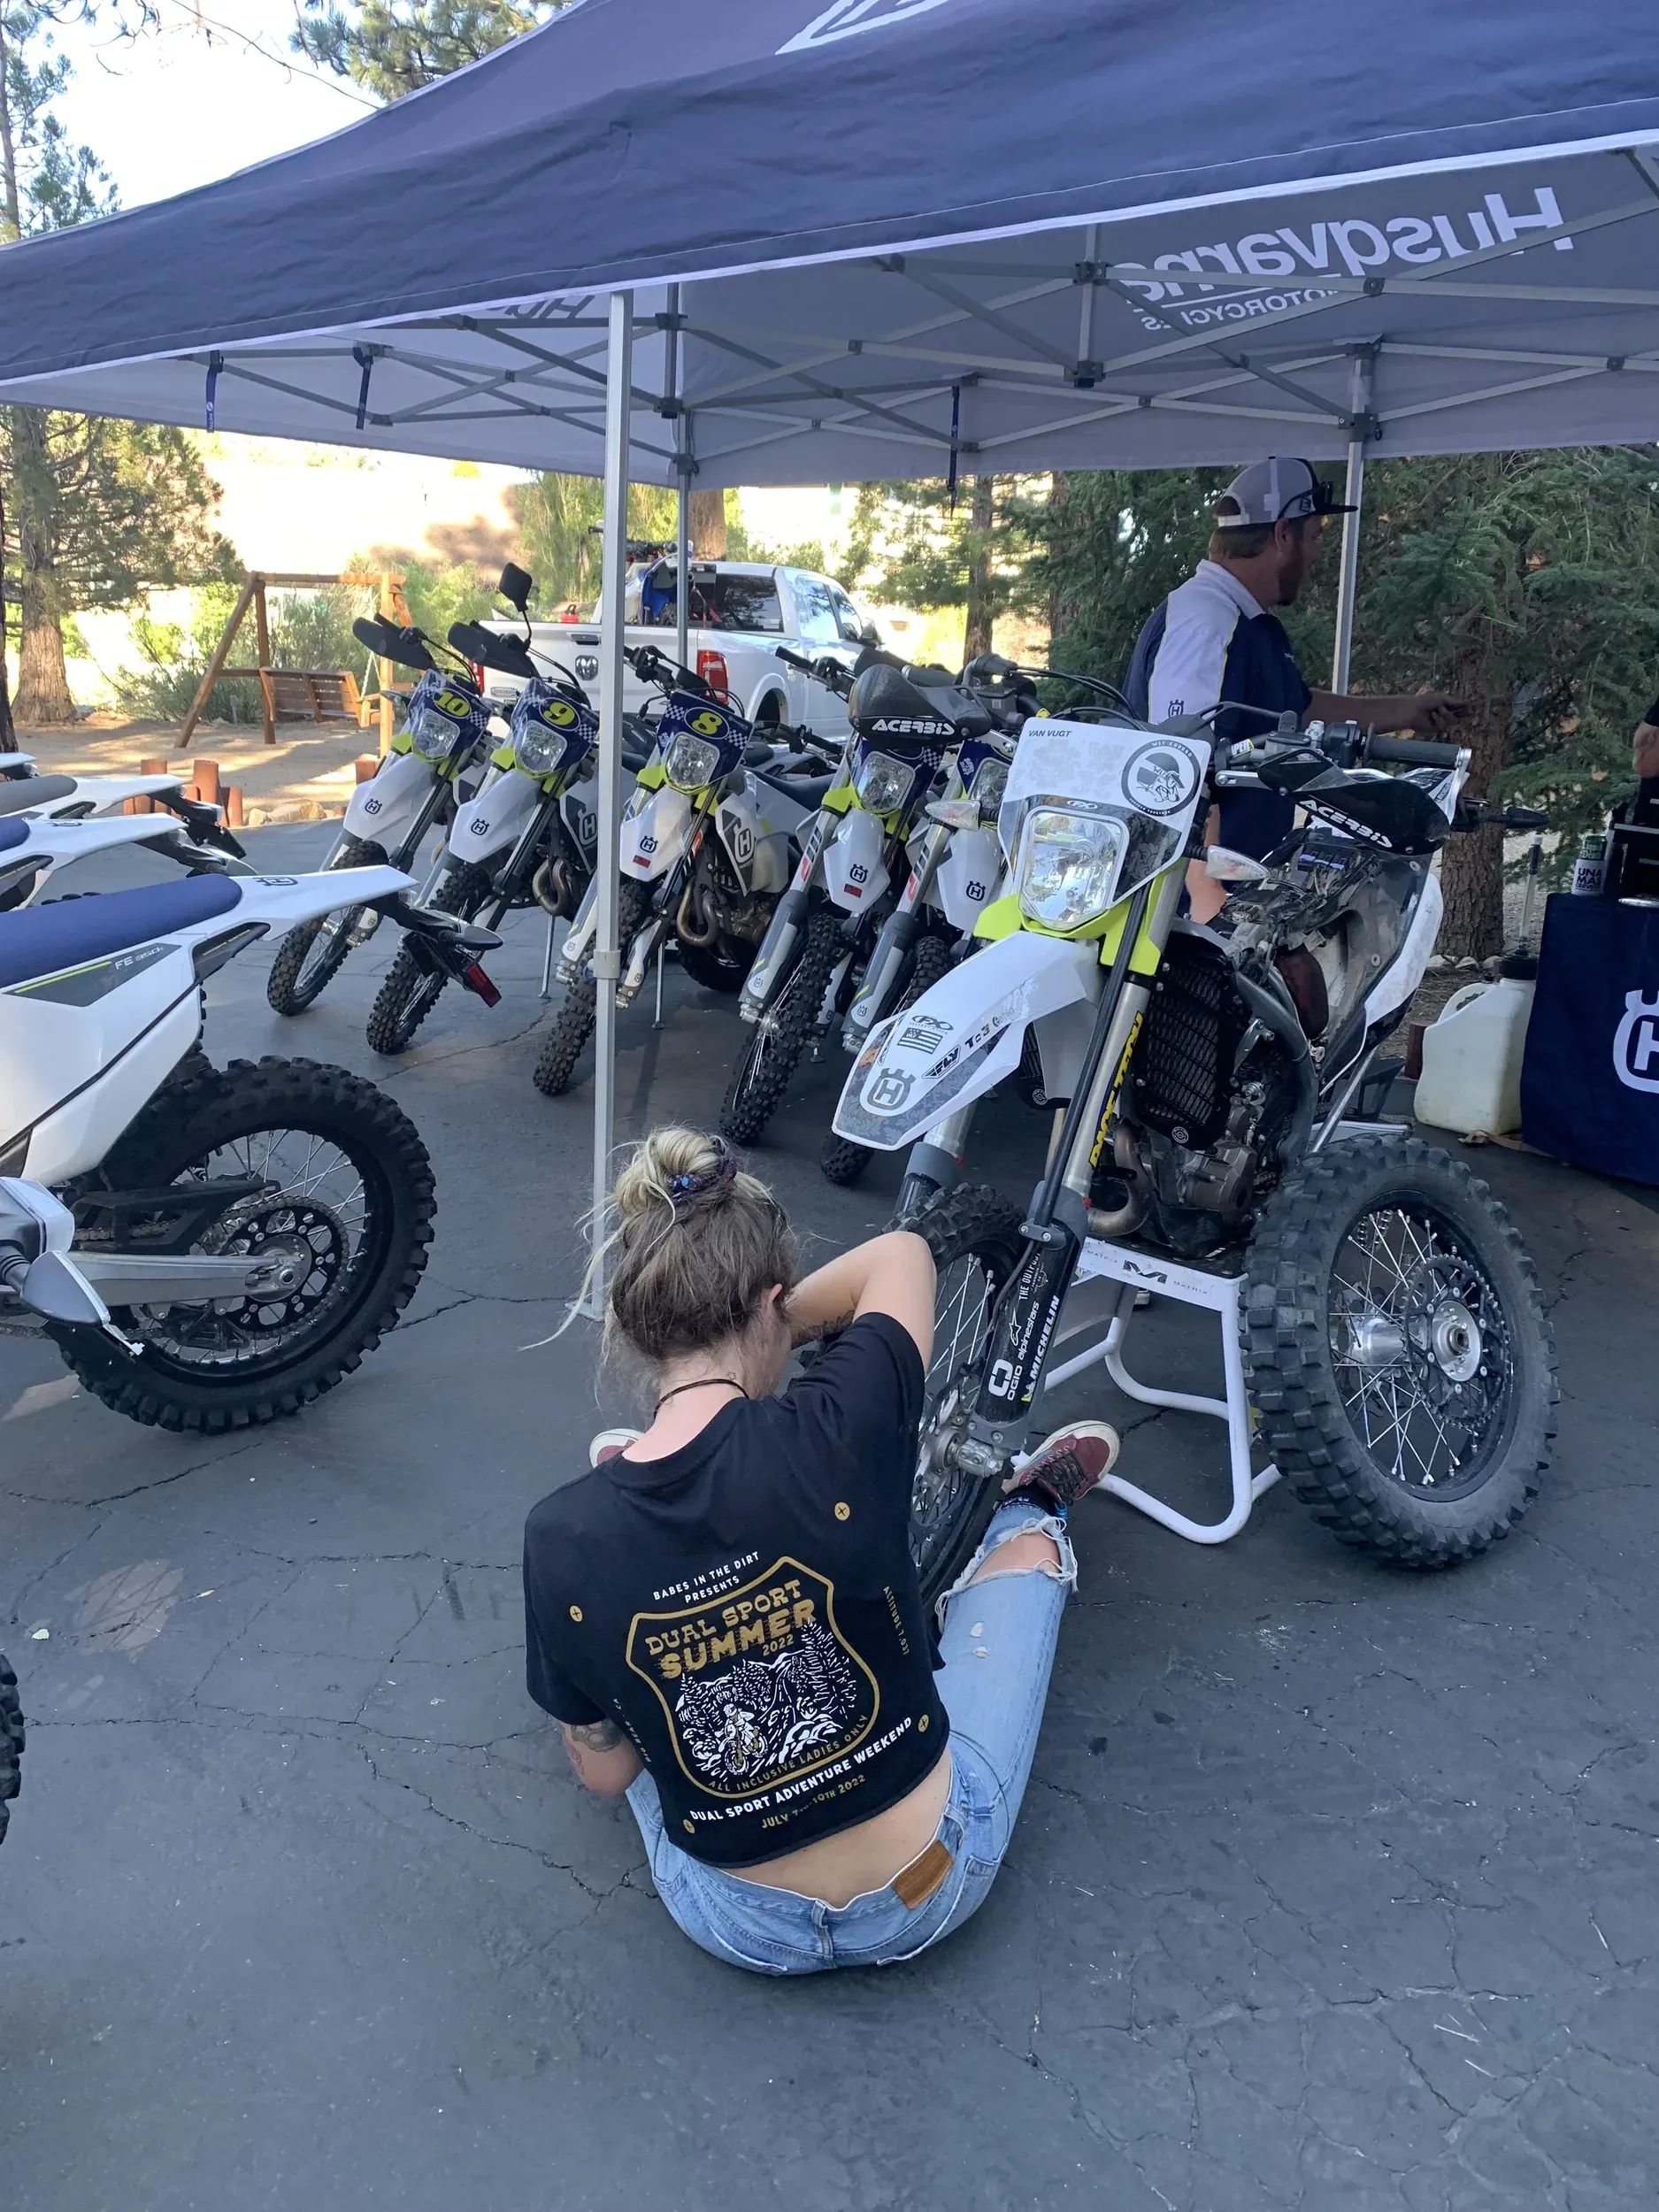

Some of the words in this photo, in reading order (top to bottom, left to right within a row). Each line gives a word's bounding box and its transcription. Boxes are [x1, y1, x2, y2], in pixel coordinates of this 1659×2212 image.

[435, 691, 471, 717] 10
[543, 702, 575, 726] 9
[691, 712, 723, 735] 8
[872, 718, 955, 735] ACERBIS
[1299, 799, 1394, 849] ACERBIS
[1578, 868, 1602, 877] UNA
[115, 956, 134, 971] FE
[932, 1047, 959, 1074] FLY
[1018, 1286, 1029, 1301] THE
[1018, 1301, 1040, 1361] alpinestars
[1030, 1294, 1060, 1380] MICHELIN
[1007, 1365, 1023, 1401] OGIO
[653, 1581, 689, 1601] BABES
[693, 1574, 707, 1586] IN
[709, 1565, 731, 1579] THE
[733, 1551, 760, 1570] DIRT
[684, 1575, 740, 1603] PRESENTS
[644, 1618, 717, 1655] DUAL
[722, 1578, 801, 1627] SPORT
[882, 1586, 902, 1629] ALTITUDE
[658, 1599, 816, 1679] SUMMER
[763, 1633, 795, 1656] 2022
[690, 1809, 724, 1821] DUAL
[726, 1796, 771, 1819] SPORT
[776, 1759, 852, 1804] ADVENTURE
[854, 1716, 912, 1764] WEEKEND
[709, 1779, 731, 1792] ALL
[737, 1760, 795, 1791] INCLUSIVE
[799, 1740, 841, 1764] LADIES
[844, 1715, 868, 1742] ONLY
[761, 1813, 790, 1830] JULY
[838, 1774, 866, 1794] 2022
